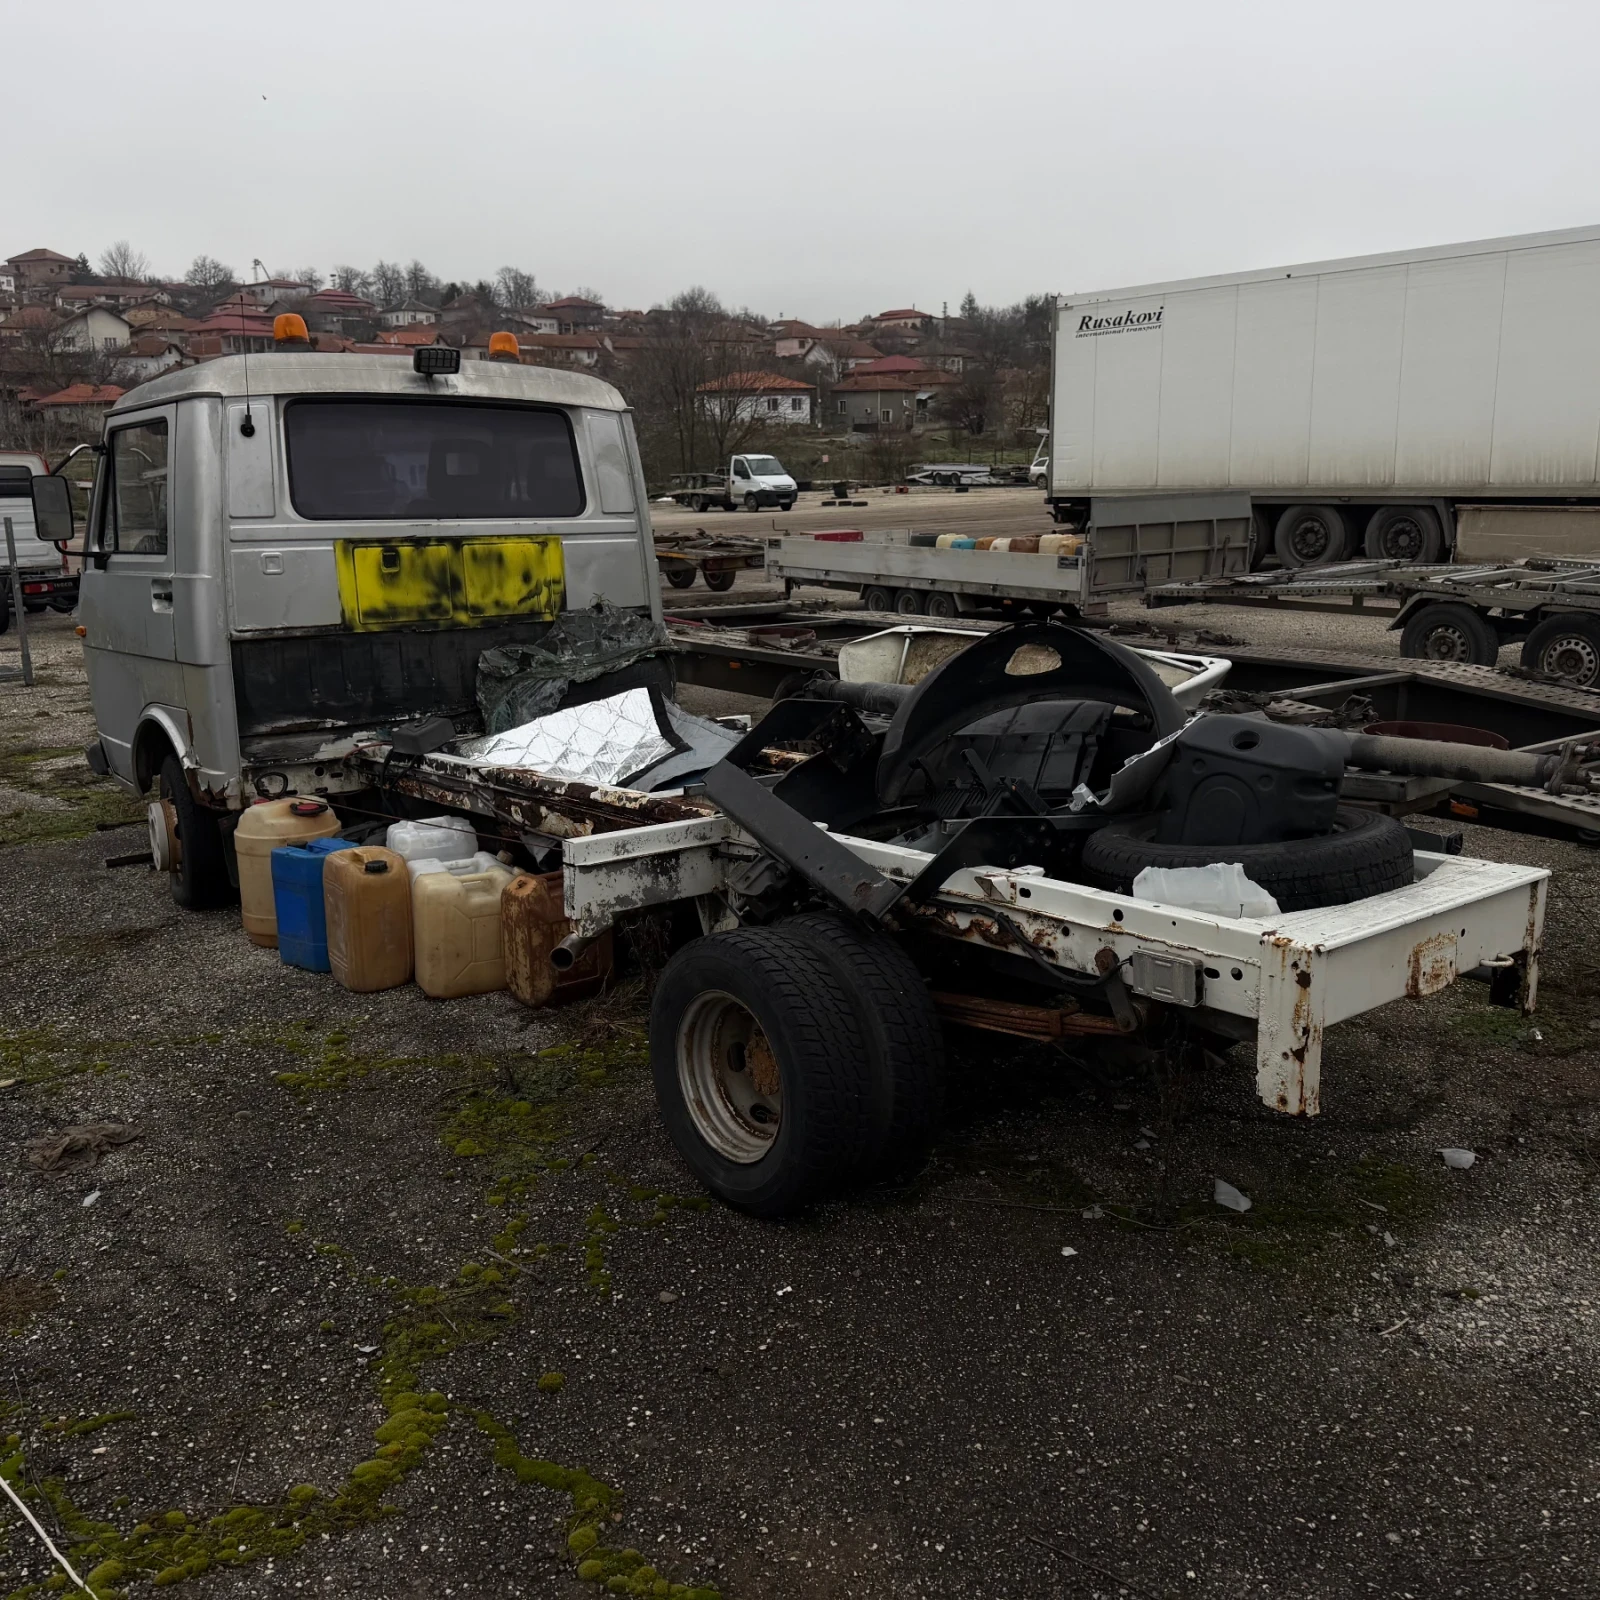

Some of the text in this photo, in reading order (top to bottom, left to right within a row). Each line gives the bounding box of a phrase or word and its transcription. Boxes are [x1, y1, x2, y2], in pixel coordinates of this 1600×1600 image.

[1078, 306, 1164, 331] Rusakovi
[1075, 324, 1162, 338] international transport
